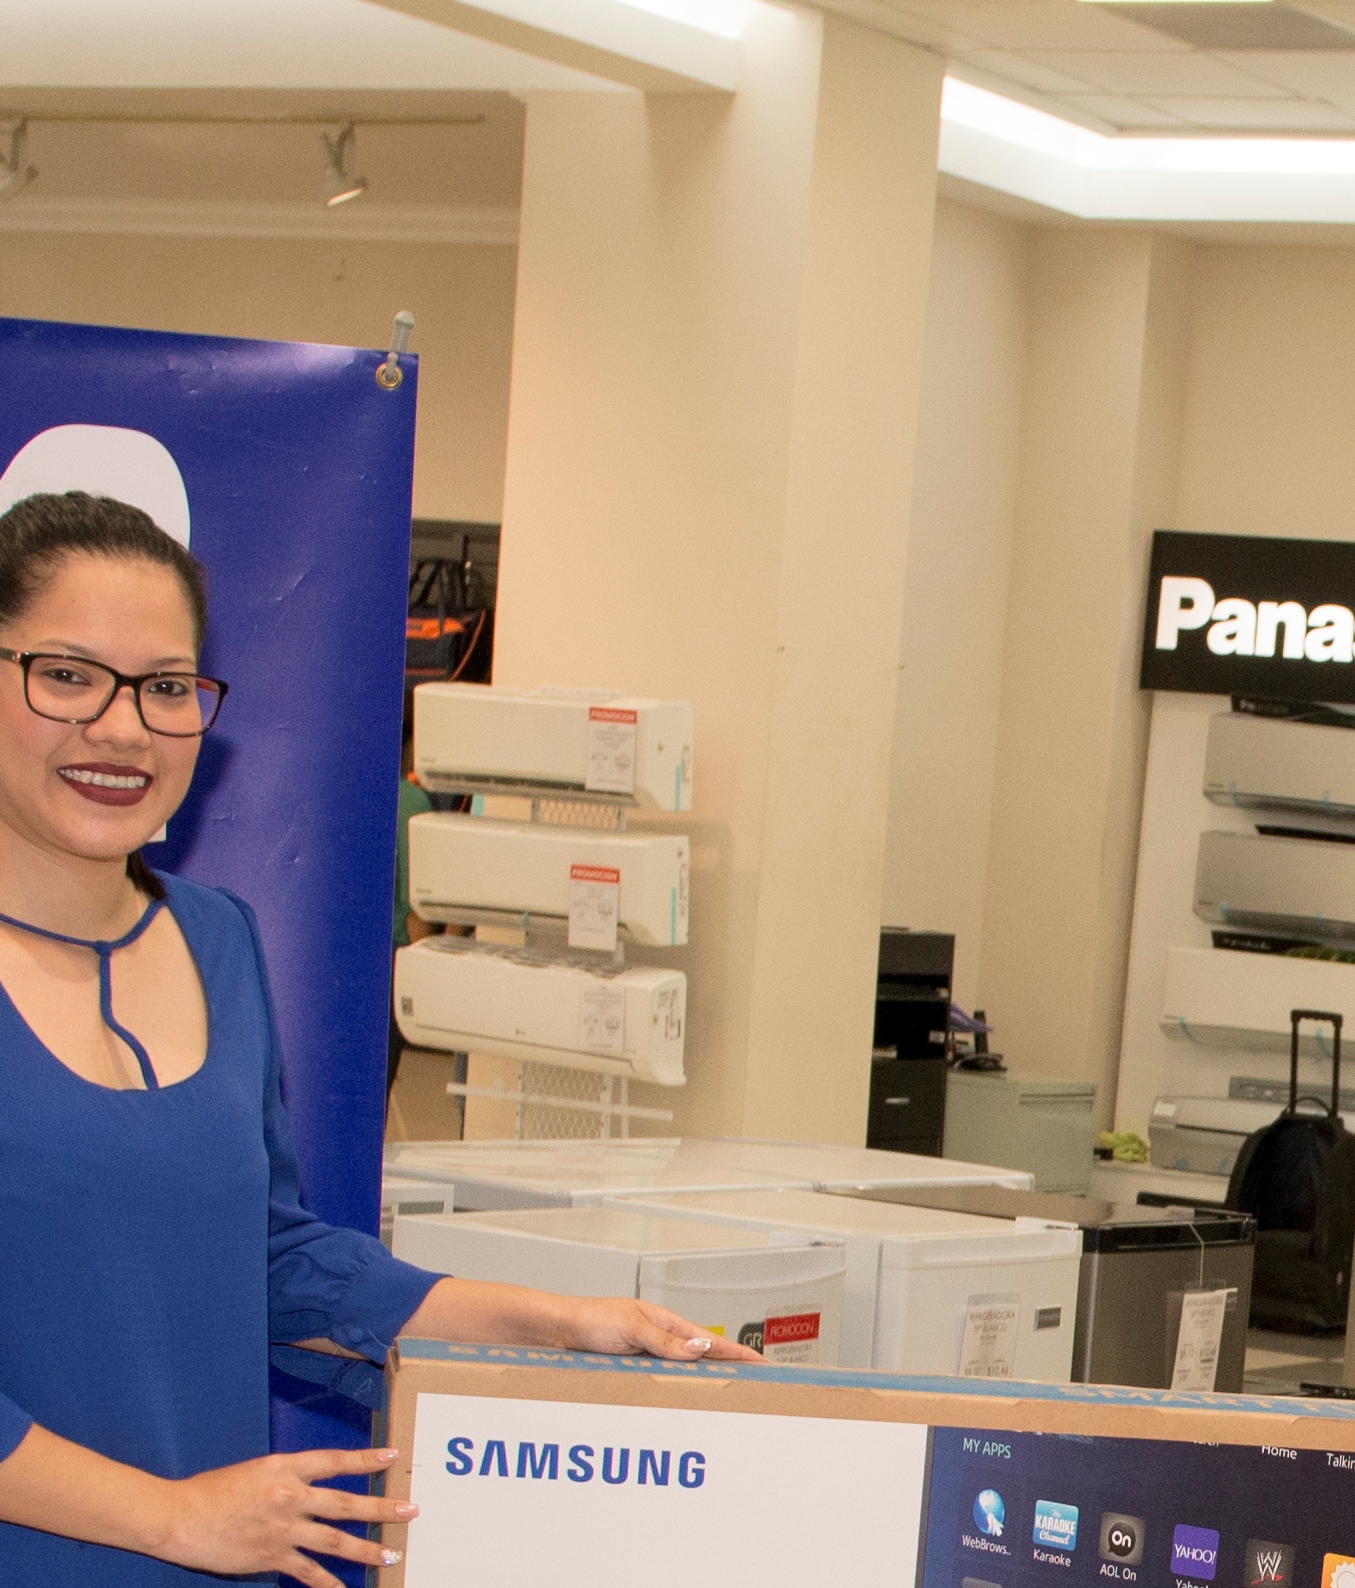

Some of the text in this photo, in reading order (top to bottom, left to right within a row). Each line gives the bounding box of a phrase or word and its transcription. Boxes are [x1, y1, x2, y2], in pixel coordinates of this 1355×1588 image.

[770, 1322, 815, 1337] PROMOCION
[963, 1438, 1011, 1459] MY APPS
[445, 1436, 707, 1489] SAMSUNG
[1035, 1514, 1076, 1534] KARAOKE
[1111, 1531, 1131, 1548] On
[1033, 1549, 1071, 1566] Karaoke
[1174, 1541, 1217, 1565] YAHOO!
[1100, 1564, 1136, 1581] AOL On
